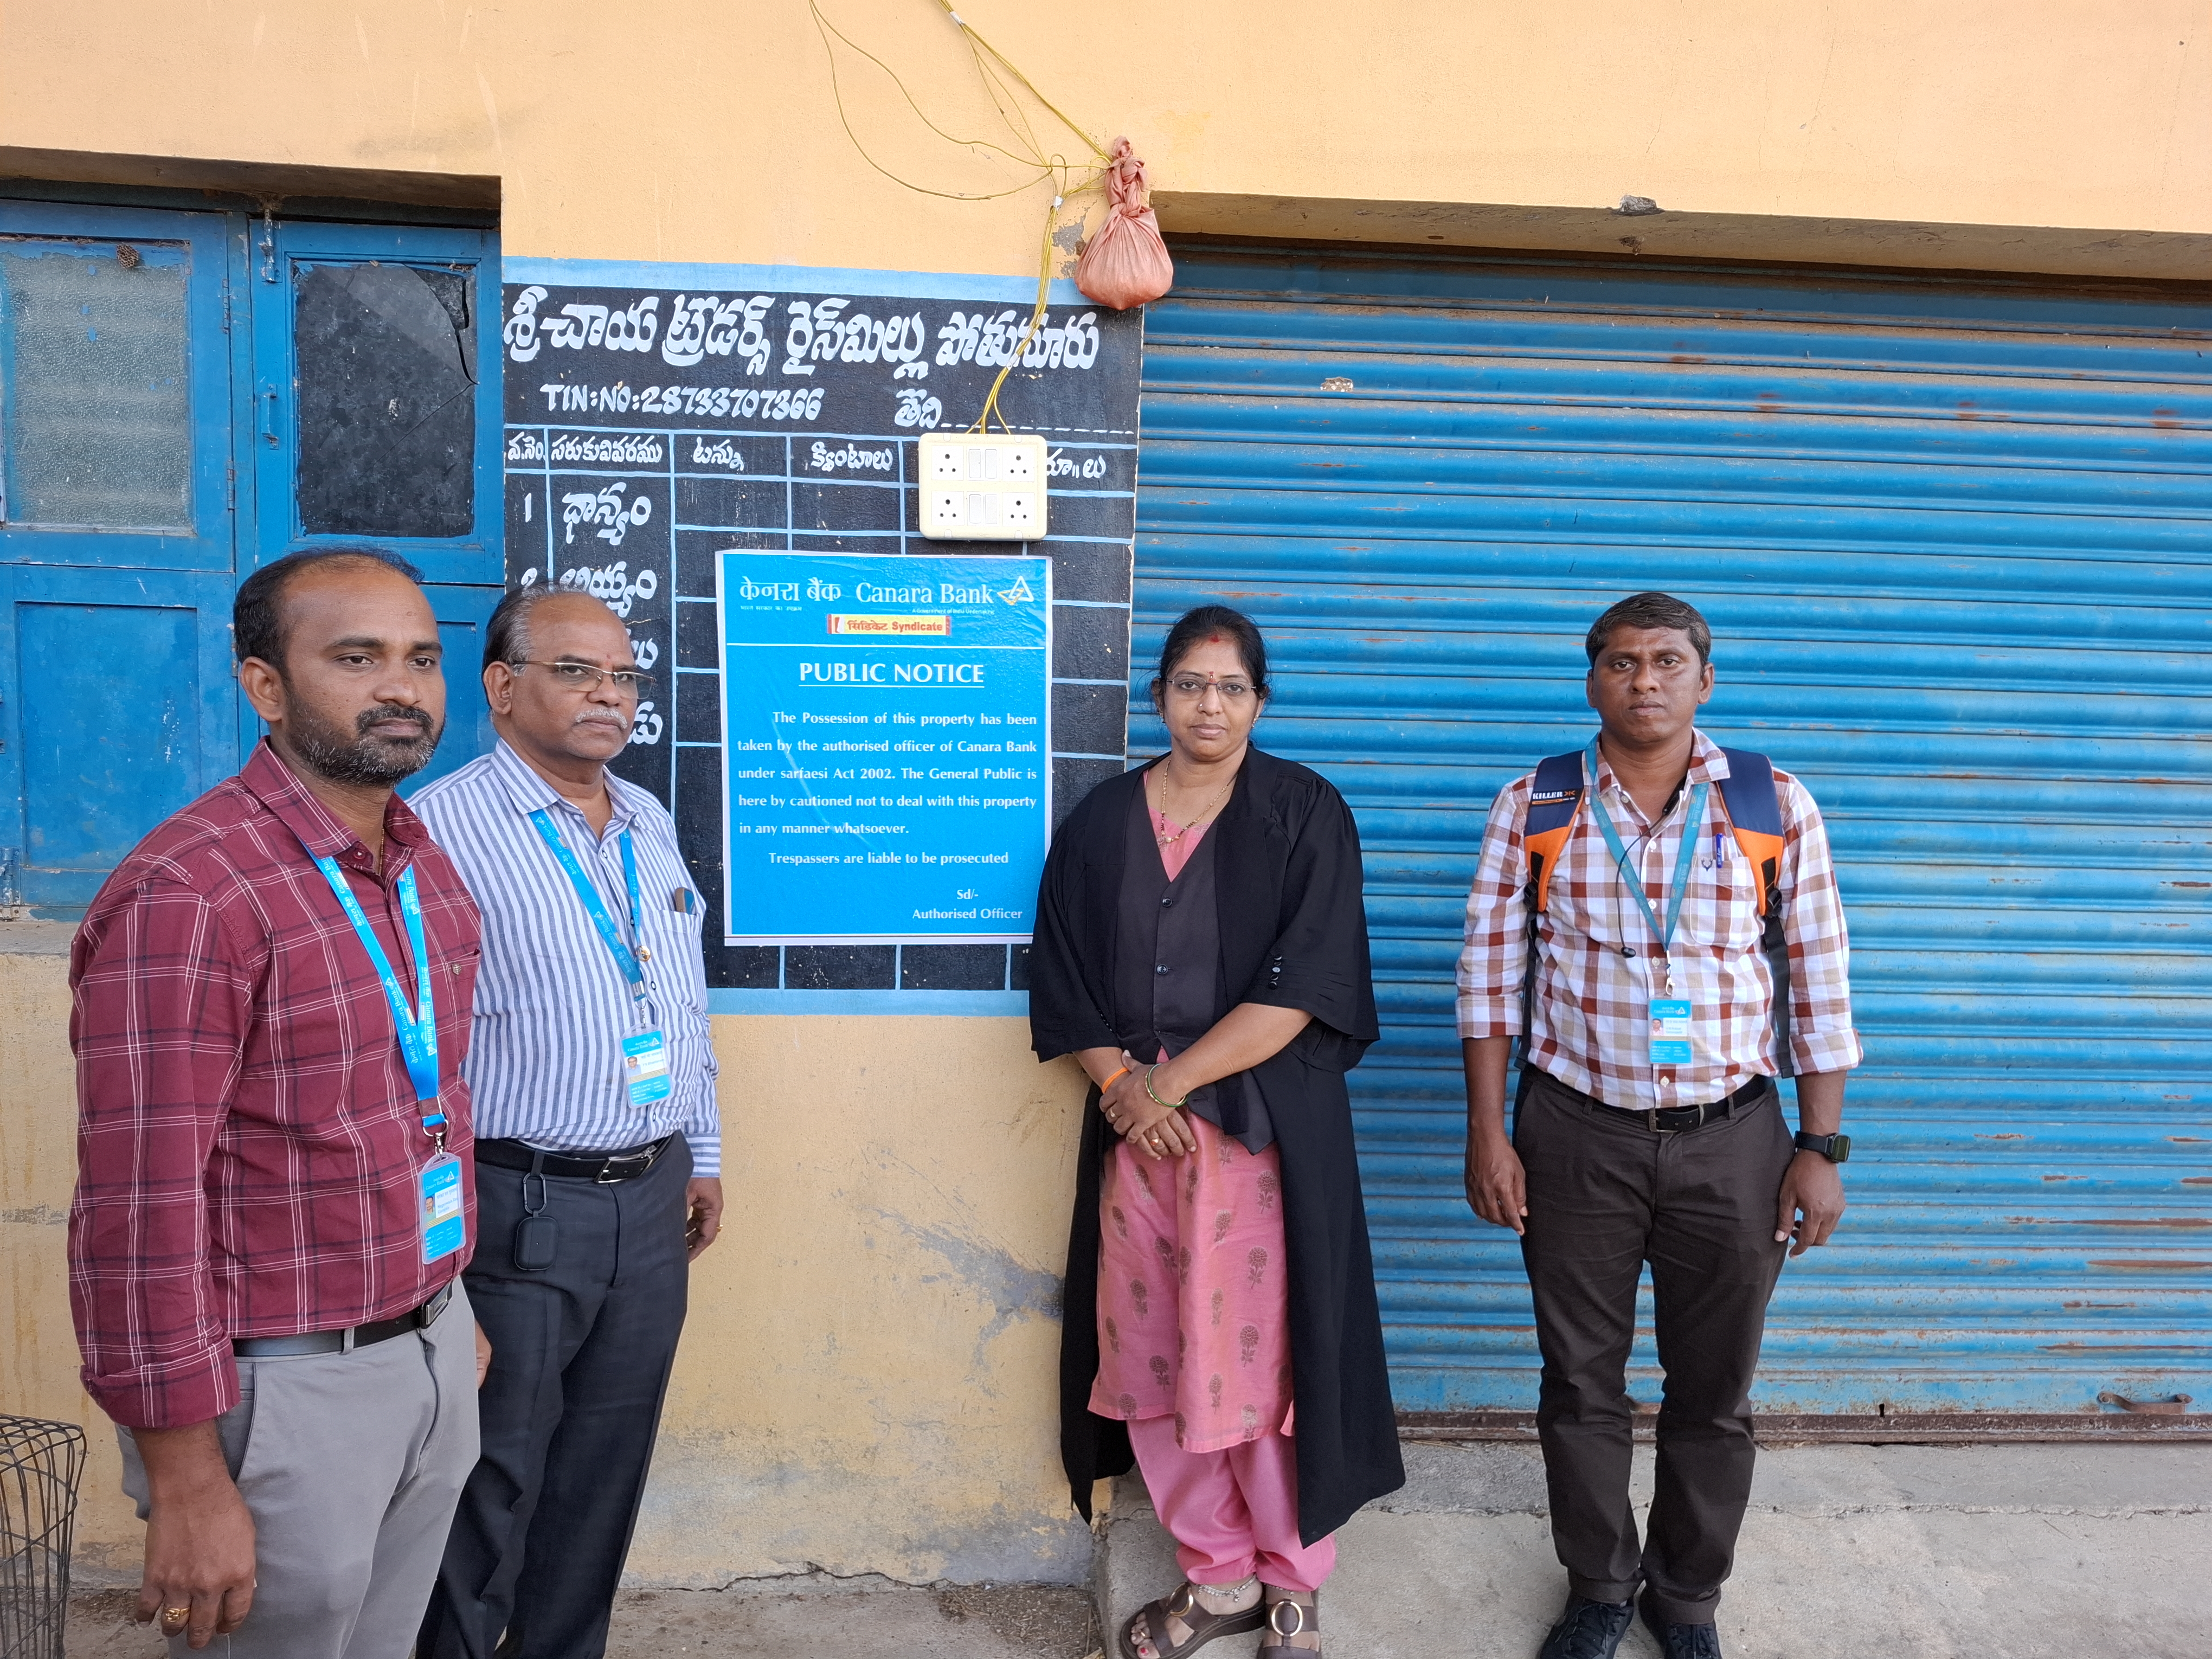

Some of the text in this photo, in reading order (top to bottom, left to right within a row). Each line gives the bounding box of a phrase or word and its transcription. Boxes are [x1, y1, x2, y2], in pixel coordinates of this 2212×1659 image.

[740, 576, 841, 601] केनरा बैंक
[856, 582, 994, 604] Canara Bank
[891, 621, 943, 633] Syndicate
[800, 663, 984, 683] PUBLIC NOTICE
[773, 711, 1037, 727] The Possession of this property has been
[737, 738, 1037, 754] taken by the authorised officer of Canara Bank
[738, 767, 1037, 779] under sarfaesi Act 2002. The General Public is
[739, 794, 1037, 809] here by cautioned not to deal with this property
[1532, 791, 1563, 800] KILLER
[740, 822, 909, 837] in any manner whatsoever.
[768, 852, 1008, 866] Trespassers are liable to be prosecuted
[957, 889, 979, 899] Sd/-
[912, 908, 1023, 919] Authorised Officer
